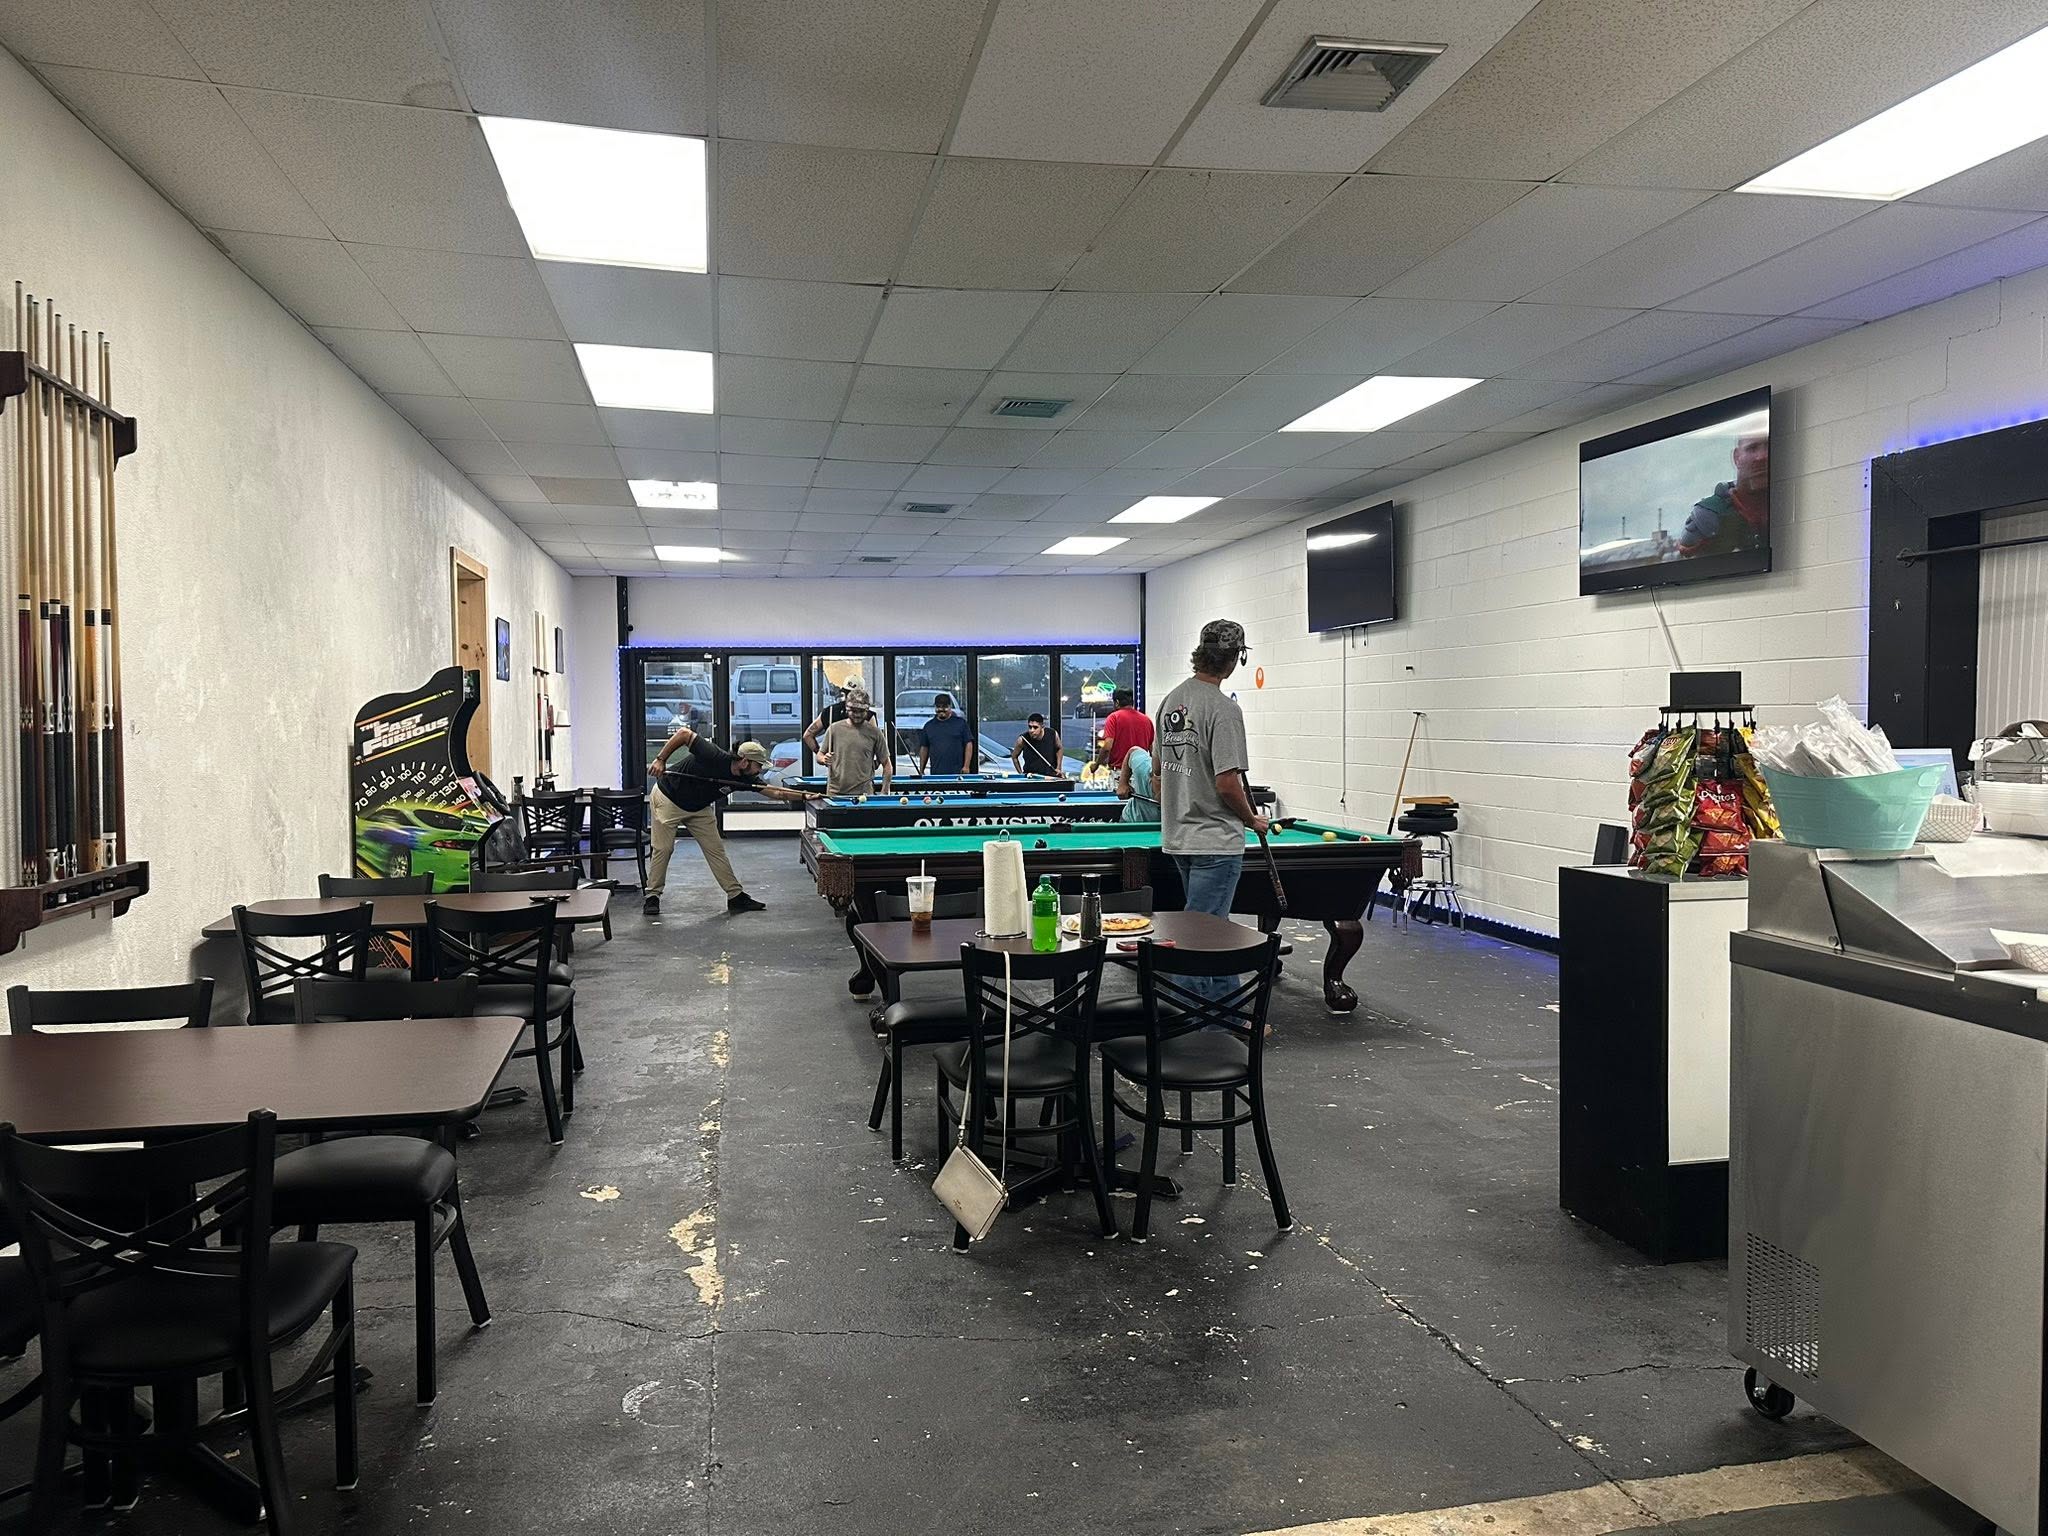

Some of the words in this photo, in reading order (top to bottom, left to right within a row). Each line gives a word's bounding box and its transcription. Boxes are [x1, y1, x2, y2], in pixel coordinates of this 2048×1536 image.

[374, 713, 423, 738] FAST
[362, 716, 449, 756] FURIOUS
[379, 775, 396, 790] 90
[397, 769, 412, 782] 100
[410, 770, 427, 785] 110
[428, 773, 444, 786] 120
[364, 785, 378, 797] 80
[439, 780, 458, 797] 130
[354, 797, 369, 812] 70
[425, 791, 439, 803] 200
[450, 793, 467, 806] 140
